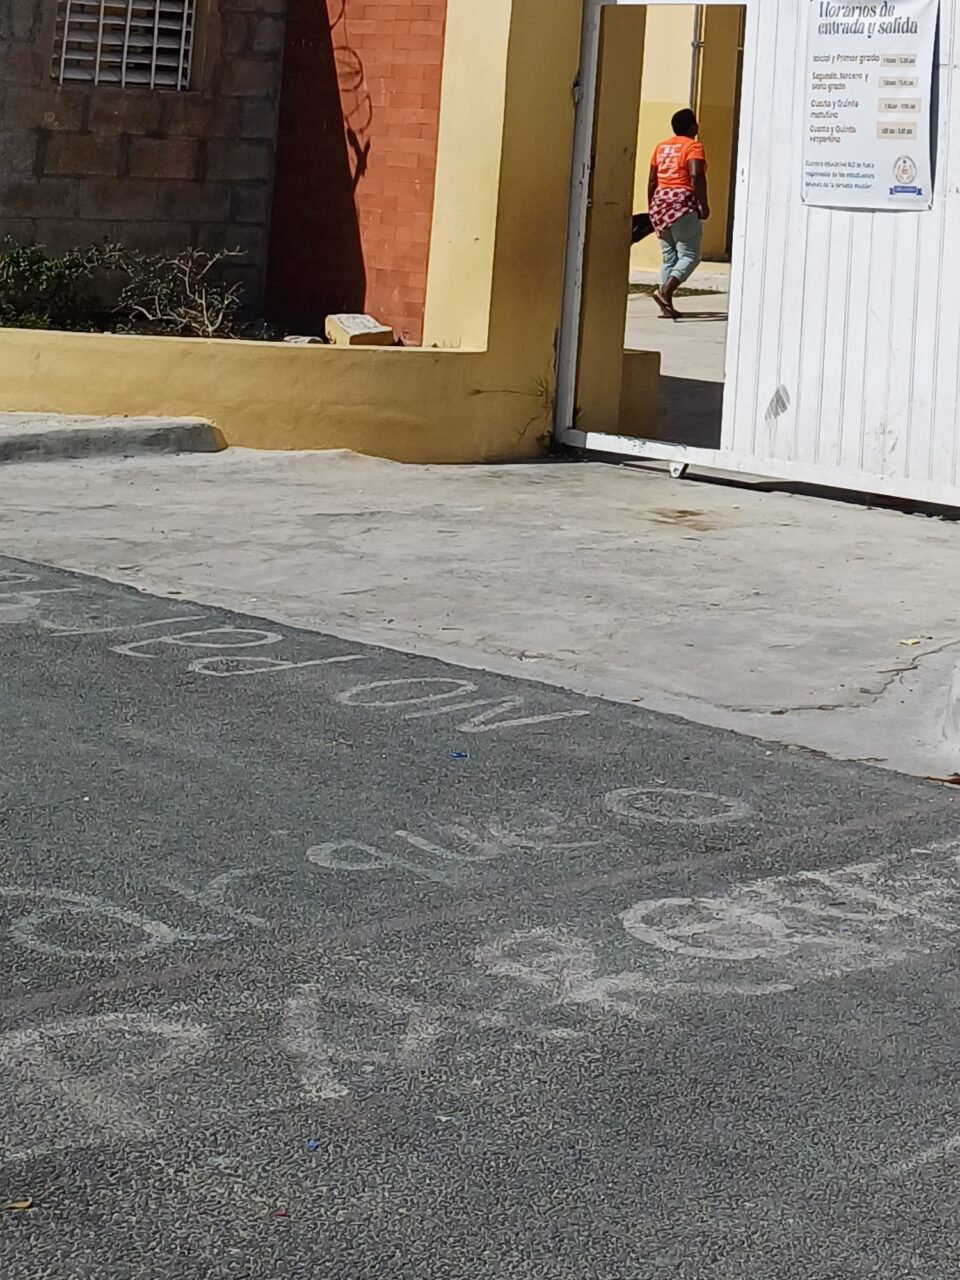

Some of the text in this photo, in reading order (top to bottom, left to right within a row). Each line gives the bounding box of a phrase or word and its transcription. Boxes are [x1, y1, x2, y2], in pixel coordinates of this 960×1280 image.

[819, 0, 896, 18] Horarios de
[818, 16, 918, 39] entrada y salida
